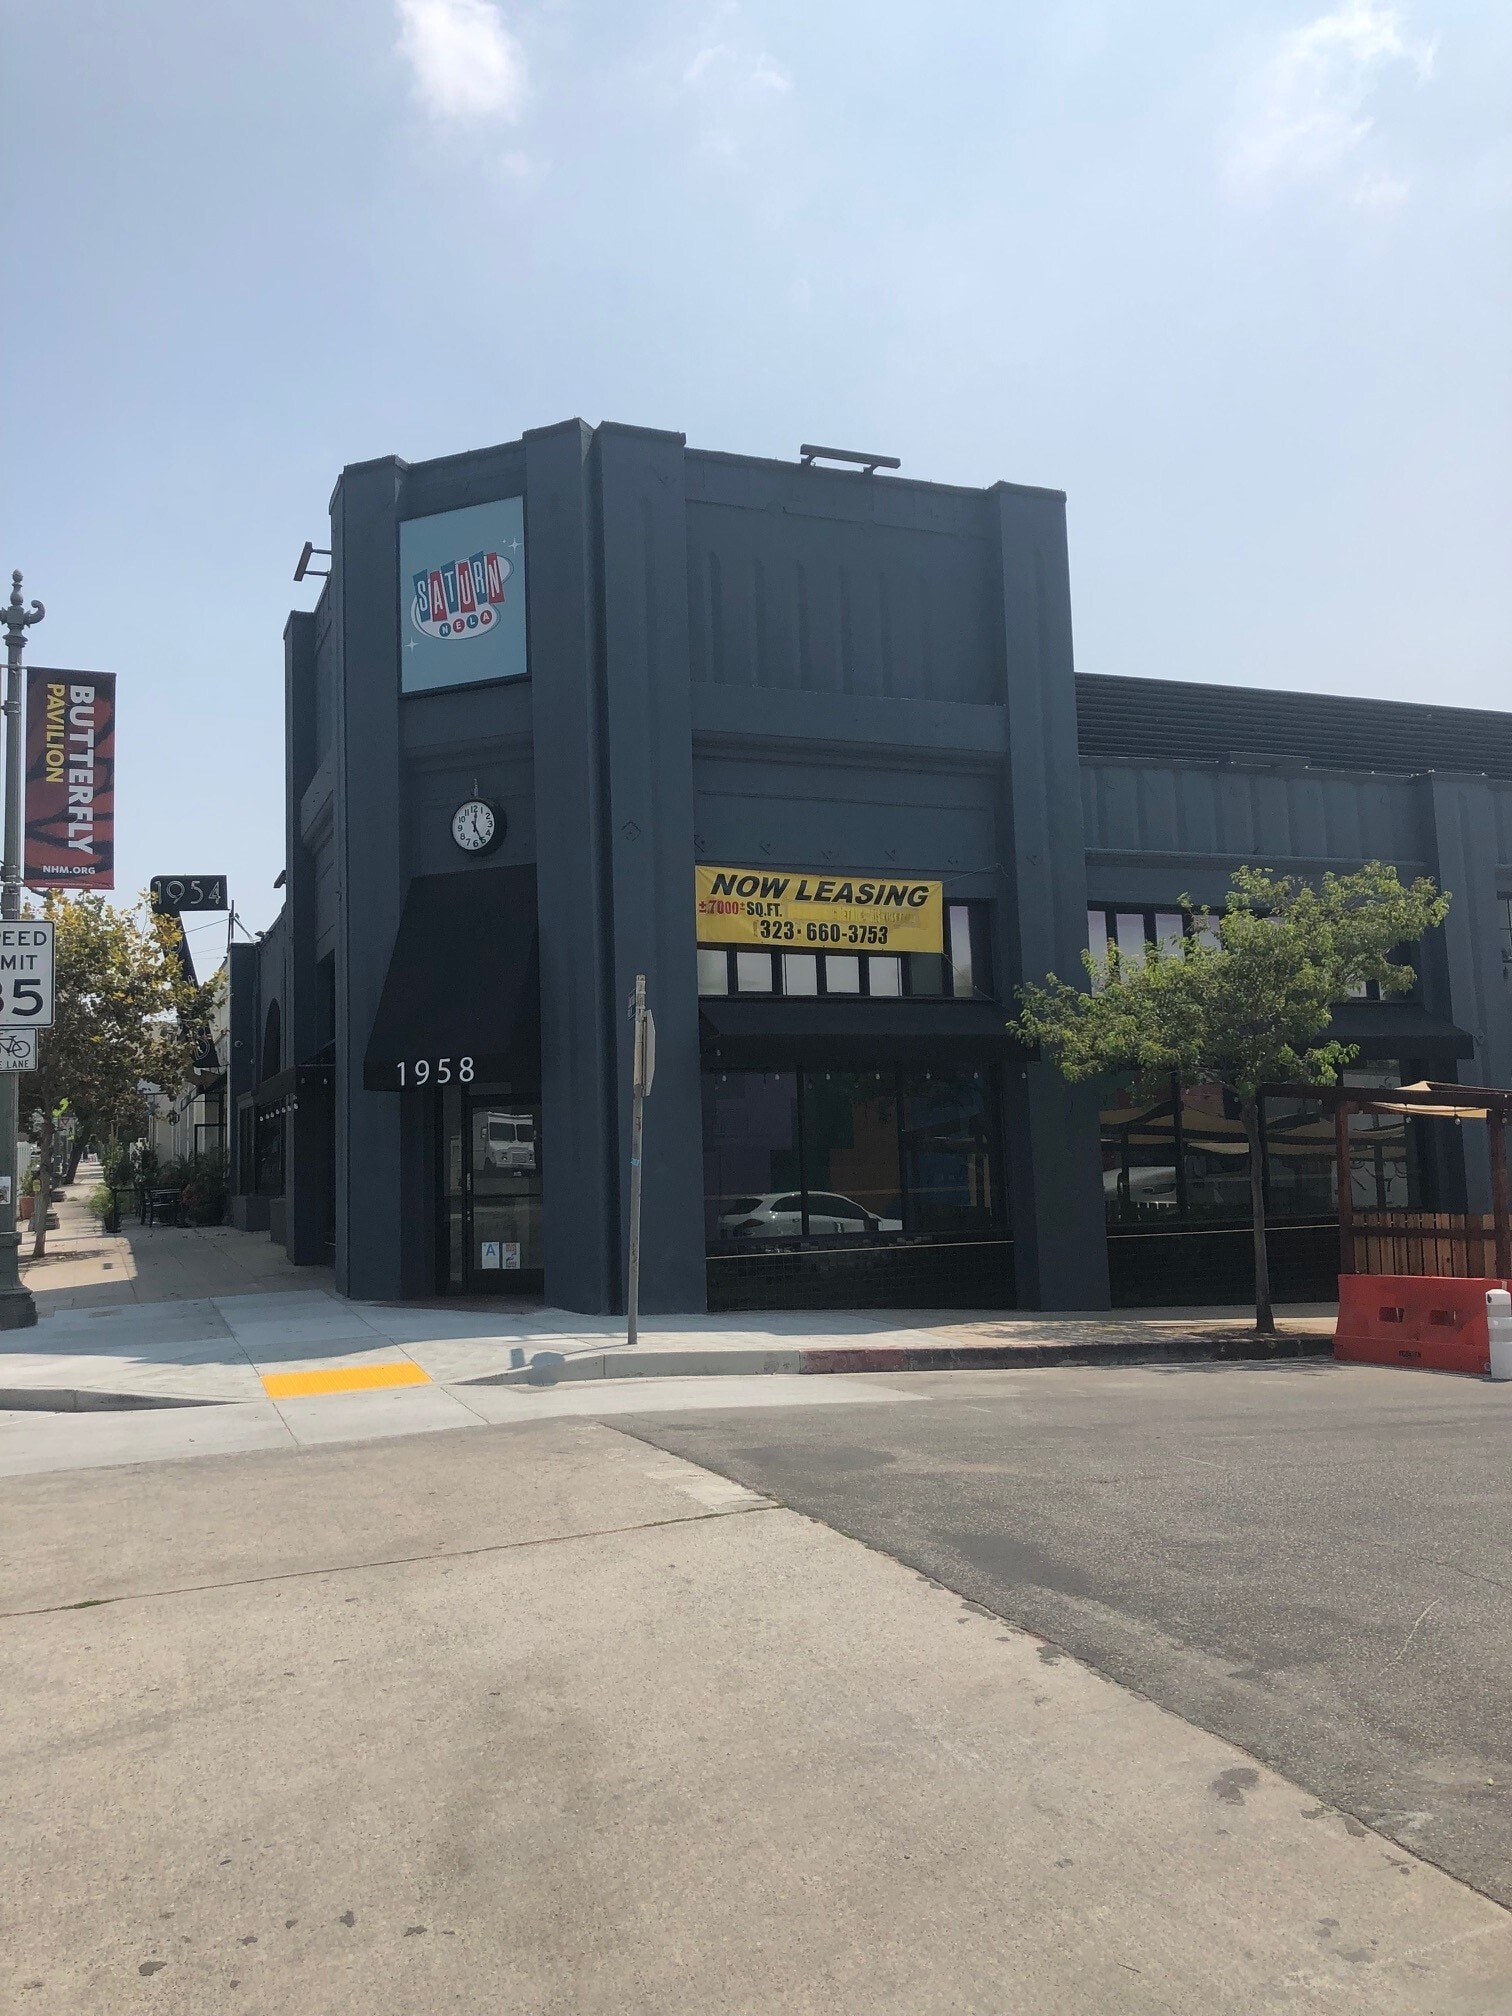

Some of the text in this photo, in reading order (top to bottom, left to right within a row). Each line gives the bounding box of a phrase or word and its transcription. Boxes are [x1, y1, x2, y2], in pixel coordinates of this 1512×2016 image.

[417, 559, 500, 615] SATURN
[442, 611, 490, 634] NELA
[46, 683, 66, 783] PAVILION
[68, 685, 95, 855] BUTTERFLY
[470, 805, 478, 813] 12
[42, 865, 96, 875] NHM.ORG
[154, 880, 221, 905] 1954
[710, 873, 930, 907] NOW LEASING
[0, 930, 47, 946] EED
[0, 978, 44, 1017] 5
[7, 1059, 29, 1069] LANE
[396, 1056, 475, 1086] 1958
[485, 1243, 496, 1256] A
